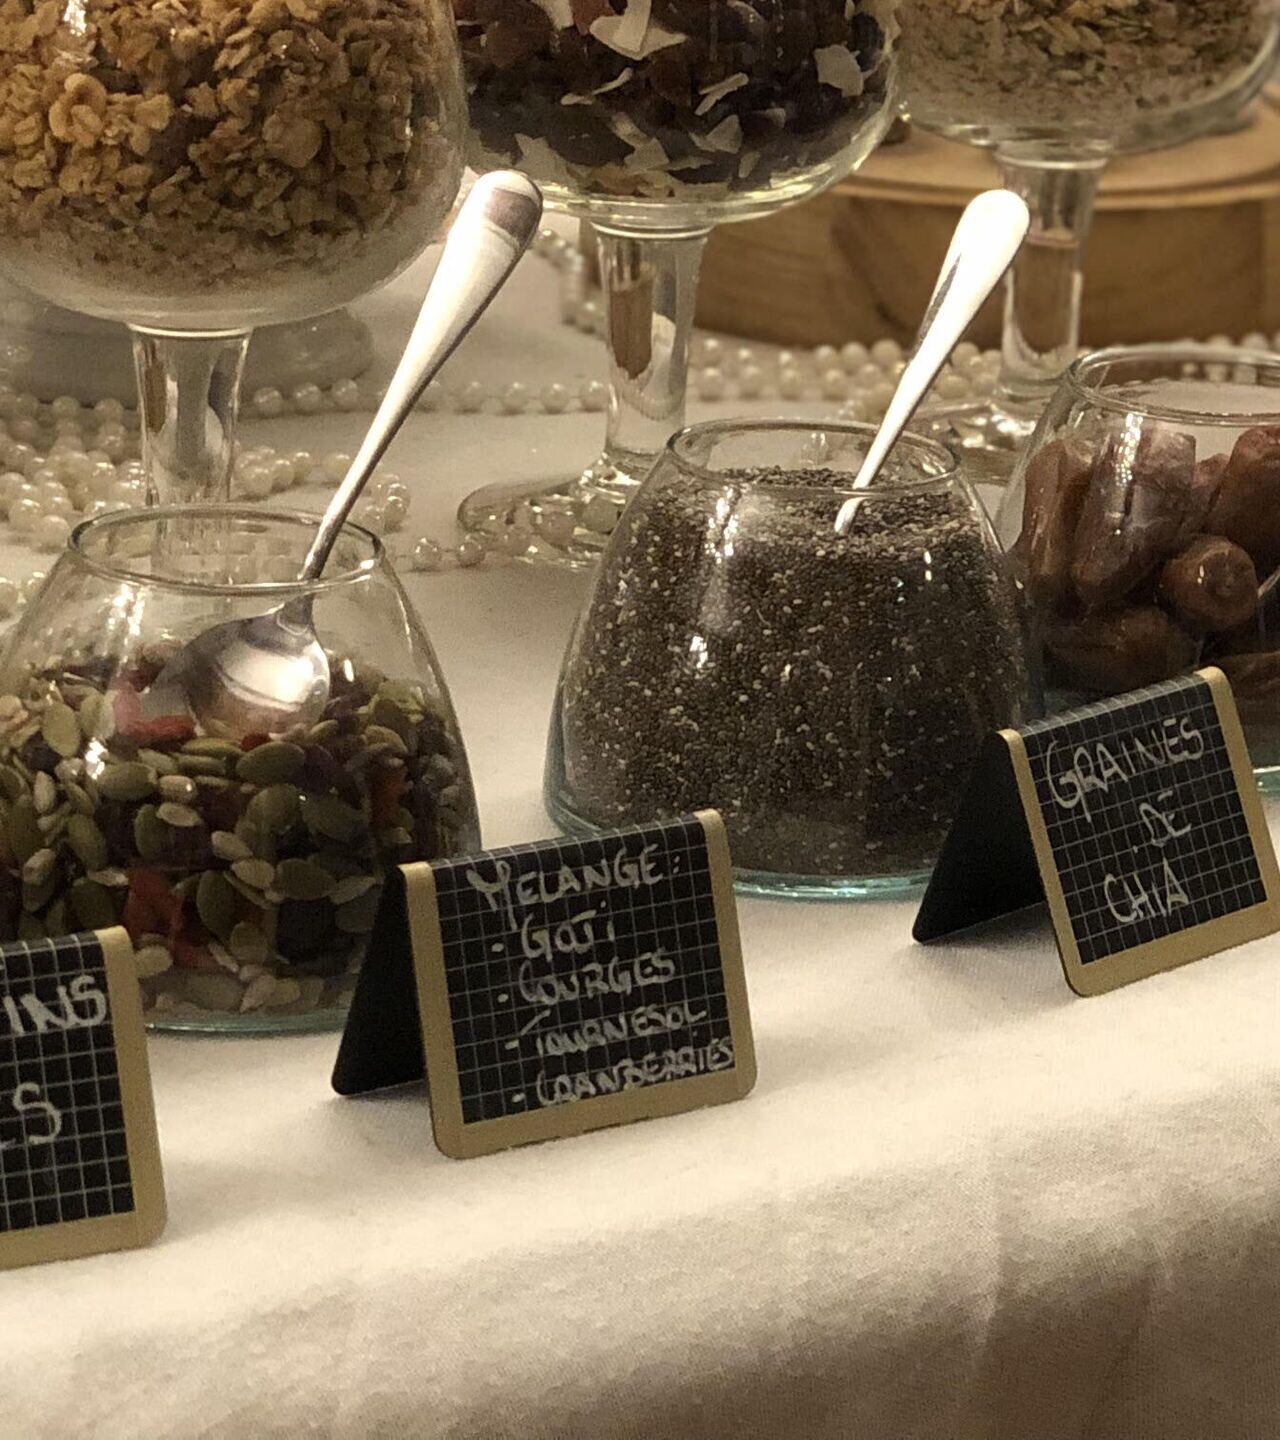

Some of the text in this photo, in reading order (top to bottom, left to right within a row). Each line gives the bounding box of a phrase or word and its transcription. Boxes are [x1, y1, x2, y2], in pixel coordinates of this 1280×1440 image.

[1045, 717, 1205, 824] GRAINES
[1139, 790, 1192, 848] DE
[1102, 856, 1190, 924] CHIA
[519, 947, 676, 1006] COURGES
